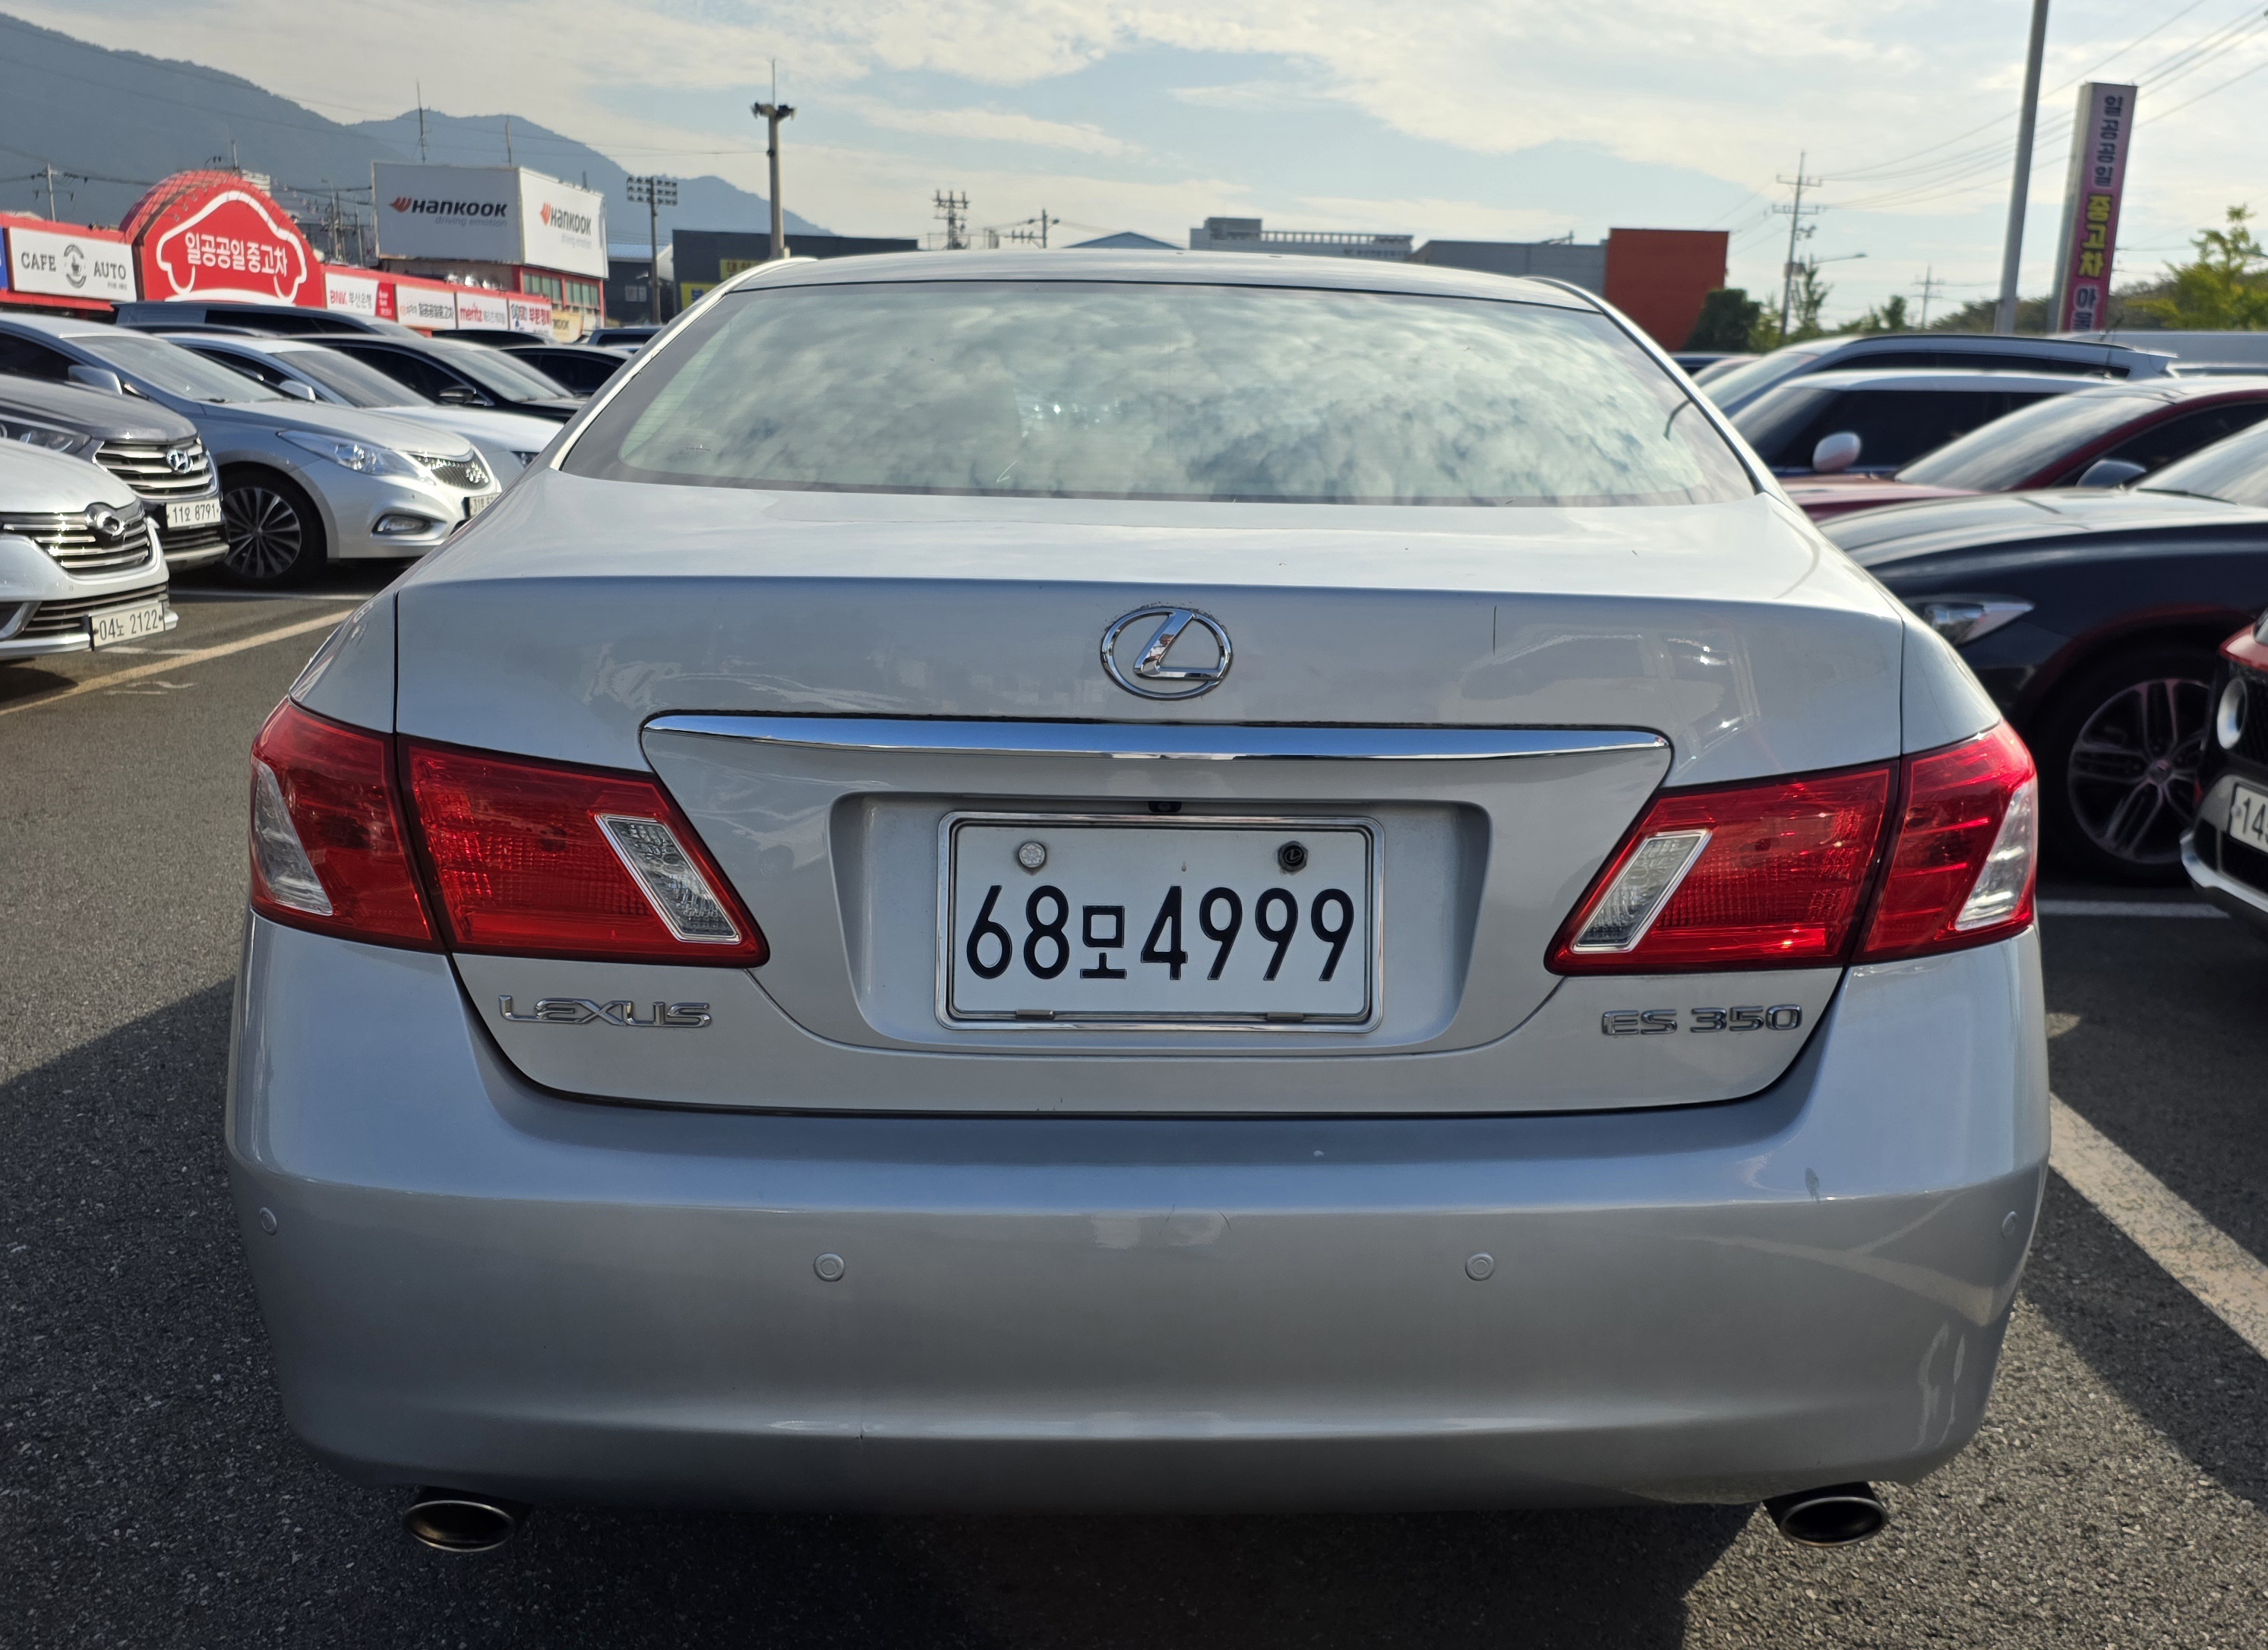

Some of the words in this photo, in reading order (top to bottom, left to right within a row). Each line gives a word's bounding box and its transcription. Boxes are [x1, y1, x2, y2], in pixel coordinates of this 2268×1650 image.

[2095, 96, 2123, 186] 일공공일
[435, 216, 466, 228] driving
[469, 217, 508, 227] emotion
[2079, 194, 2112, 278] 중고차
[21, 251, 56, 273] CAFE
[93, 261, 127, 280] AUTO
[195, 503, 216, 521] 8791
[99, 618, 125, 640] 04노
[130, 608, 159, 634] 2122
[2243, 796, 2268, 844] 14
[498, 994, 713, 1029] LEXUS
[1602, 1009, 1679, 1036] ES
[1690, 1004, 1803, 1033] 350
